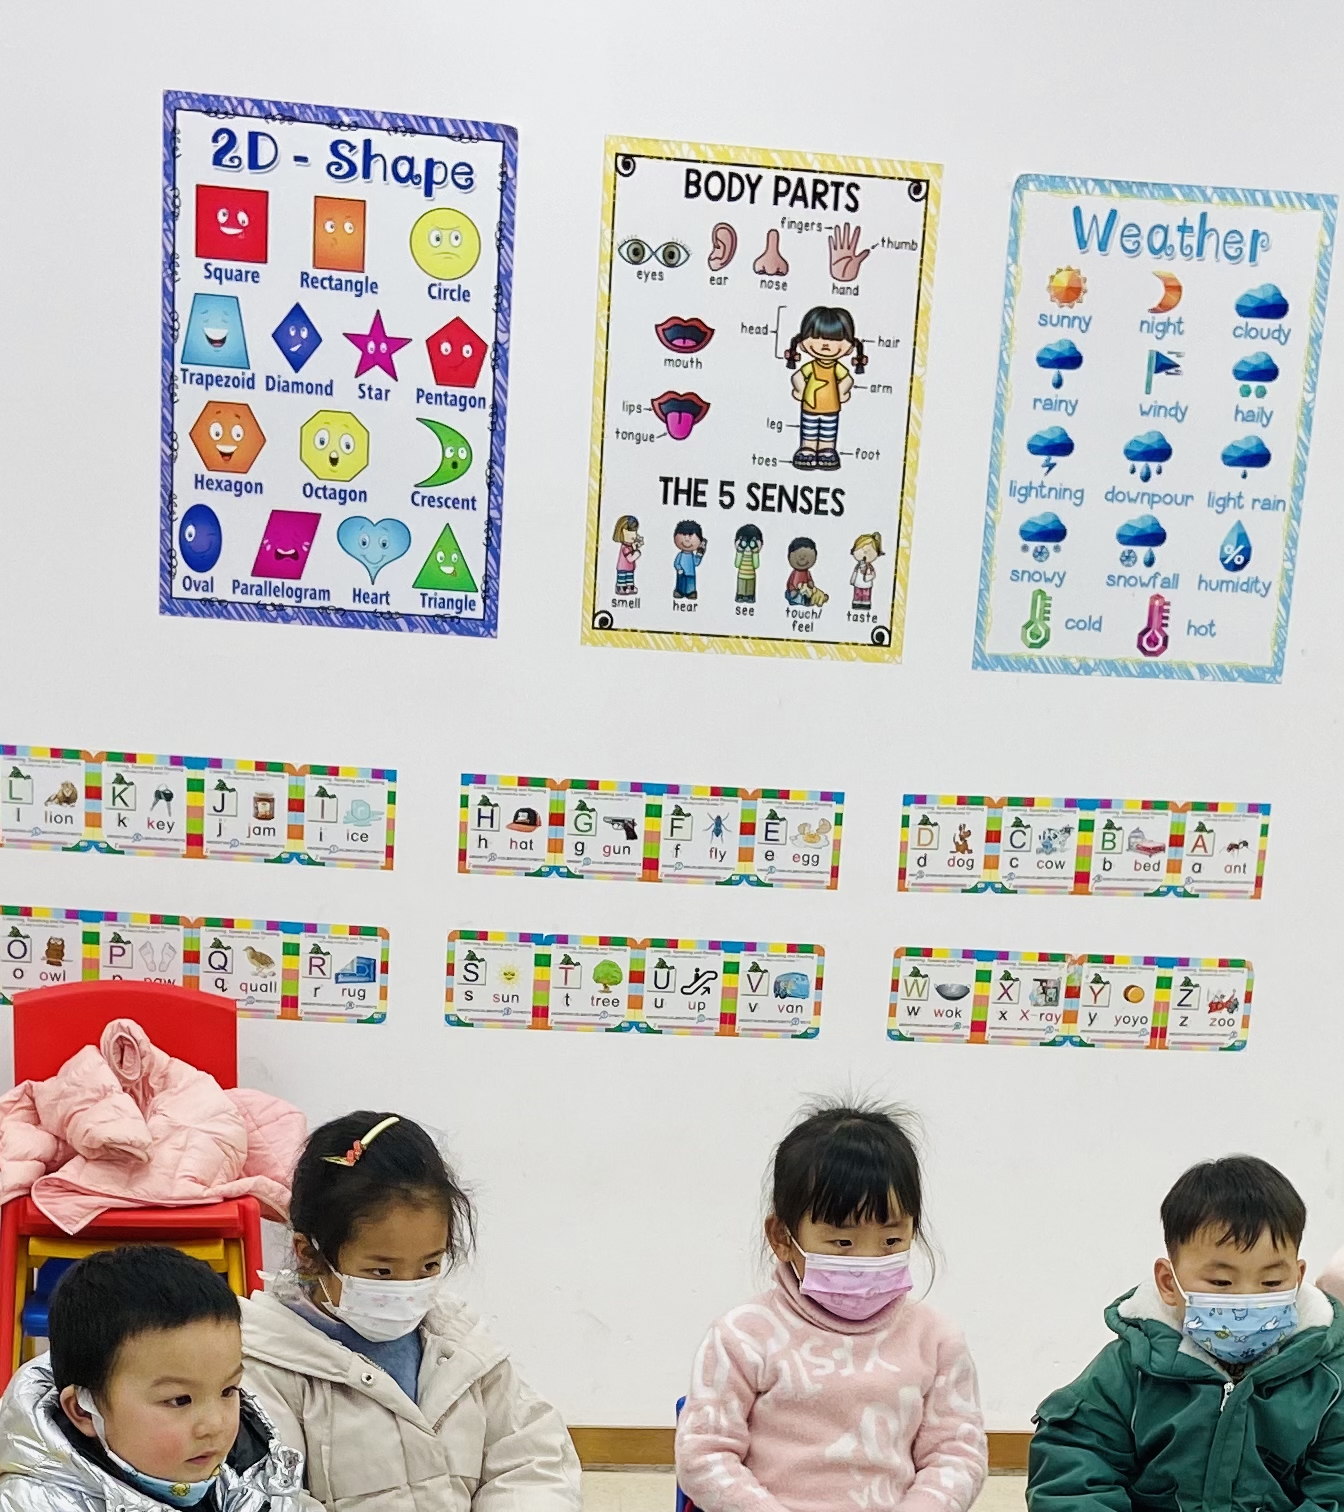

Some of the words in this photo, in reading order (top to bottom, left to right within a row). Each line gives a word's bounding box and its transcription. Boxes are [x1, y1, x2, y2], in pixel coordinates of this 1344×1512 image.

[212, 128, 278, 170] 2D
[326, 138, 474, 197] Shape
[685, 169, 762, 204] BODY
[773, 176, 860, 212] PARTS
[781, 218, 822, 232] fingers
[1072, 205, 1271, 264] Weather
[881, 237, 917, 251] thumb
[204, 263, 260, 284] Square
[637, 270, 664, 282] eyes
[709, 275, 728, 286] ear
[300, 272, 378, 297] Rectangle
[428, 284, 470, 302] Circle
[760, 278, 787, 291] nose
[832, 284, 859, 296] hand
[741, 324, 768, 335] head
[1038, 313, 1092, 333] sunny
[1140, 317, 1184, 340] night
[878, 336, 900, 347] hair
[1233, 323, 1291, 345] cloudy
[664, 357, 702, 369] mouth
[180, 368, 255, 390] Trapezoid
[265, 375, 333, 397] Diamond
[358, 384, 390, 401] Star
[870, 384, 892, 394] arm
[417, 388, 486, 411] Pentagon
[622, 402, 642, 415] lips
[1033, 395, 1078, 416] rainy
[1140, 401, 1188, 422] windy
[1234, 405, 1273, 427] haily
[767, 418, 782, 432] leg
[615, 428, 655, 444] tongue
[752, 454, 777, 467] toes
[855, 449, 880, 461] foot
[195, 474, 263, 496] Hexagon
[302, 483, 367, 505] Octagon
[1009, 480, 1084, 506] lightning
[411, 491, 477, 511] Crescent
[659, 476, 708, 507] THE
[719, 481, 734, 510] 5
[746, 483, 845, 516] SENSES
[1105, 486, 1193, 509] downpour
[1207, 493, 1244, 514] light
[1252, 495, 1286, 511] rain
[183, 576, 214, 593] Oval
[1010, 569, 1066, 588] snowy
[1106, 573, 1179, 589] snowfall
[1198, 577, 1271, 597] humidity
[232, 581, 330, 603] Parallelogram
[353, 588, 390, 605] Heart
[420, 594, 476, 614] Triangle
[612, 597, 640, 609] smell
[673, 601, 698, 612] hear
[736, 605, 754, 616] see
[792, 621, 813, 632] feel
[847, 612, 878, 623] taste
[1065, 616, 1102, 633] cold
[1187, 620, 1216, 637] hot
[9, 780, 23, 800] L
[112, 786, 129, 807] K
[213, 793, 224, 813] J
[321, 799, 324, 819] I
[17, 808, 20, 822] l
[45, 811, 73, 824] lion
[117, 813, 127, 828] k
[148, 818, 175, 834] key
[478, 808, 494, 828] H
[574, 813, 592, 833] G
[217, 819, 222, 837] j
[247, 823, 276, 838] jam
[319, 827, 322, 841] i
[346, 829, 369, 842] ice
[670, 818, 685, 837] F
[765, 822, 779, 841] E
[917, 827, 934, 847] D
[478, 835, 488, 849] h
[510, 838, 533, 850] hat
[1009, 829, 1026, 849] C
[1102, 832, 1116, 851] B
[1191, 834, 1208, 853] A
[575, 841, 585, 855] g
[603, 844, 630, 857] gun
[674, 844, 680, 858] f
[709, 847, 726, 862] fly
[765, 850, 774, 861] e
[793, 853, 819, 866] egg
[917, 853, 927, 867] d
[948, 856, 975, 870] dog
[1010, 858, 1019, 868] c
[1037, 859, 1065, 870] cow
[1103, 857, 1112, 871] b
[1134, 859, 1160, 872] bed
[1192, 863, 1202, 873] a
[1224, 863, 1246, 874] ant
[7, 939, 27, 959] O
[110, 945, 125, 965] P
[208, 950, 228, 971] Q
[309, 956, 326, 976] R
[13, 968, 24, 979] o
[40, 970, 66, 982] owl
[463, 963, 479, 982] S
[559, 965, 574, 986] T
[654, 970, 669, 989] U
[215, 977, 228, 992] q
[747, 973, 764, 992] V
[904, 979, 927, 998] W
[998, 982, 1014, 1001] X
[313, 986, 320, 997] r
[342, 987, 366, 1000] rug
[465, 990, 473, 1001] s
[493, 993, 519, 1003] sun
[564, 993, 570, 1006] t
[591, 995, 619, 1007] tree
[1089, 985, 1104, 1004] Y
[1177, 989, 1193, 1007] Z
[655, 998, 663, 1009] u
[688, 1001, 706, 1013] up
[749, 1003, 758, 1012] v
[778, 1004, 803, 1014] van
[907, 1006, 921, 1016] w
[934, 1007, 962, 1018] wok
[999, 1010, 1007, 1021] x
[1019, 1009, 1062, 1025] X-ray
[1088, 1012, 1098, 1026] y
[1114, 1014, 1148, 1027] yoyo
[1179, 1016, 1188, 1026] z
[1209, 1018, 1235, 1027] zoo
